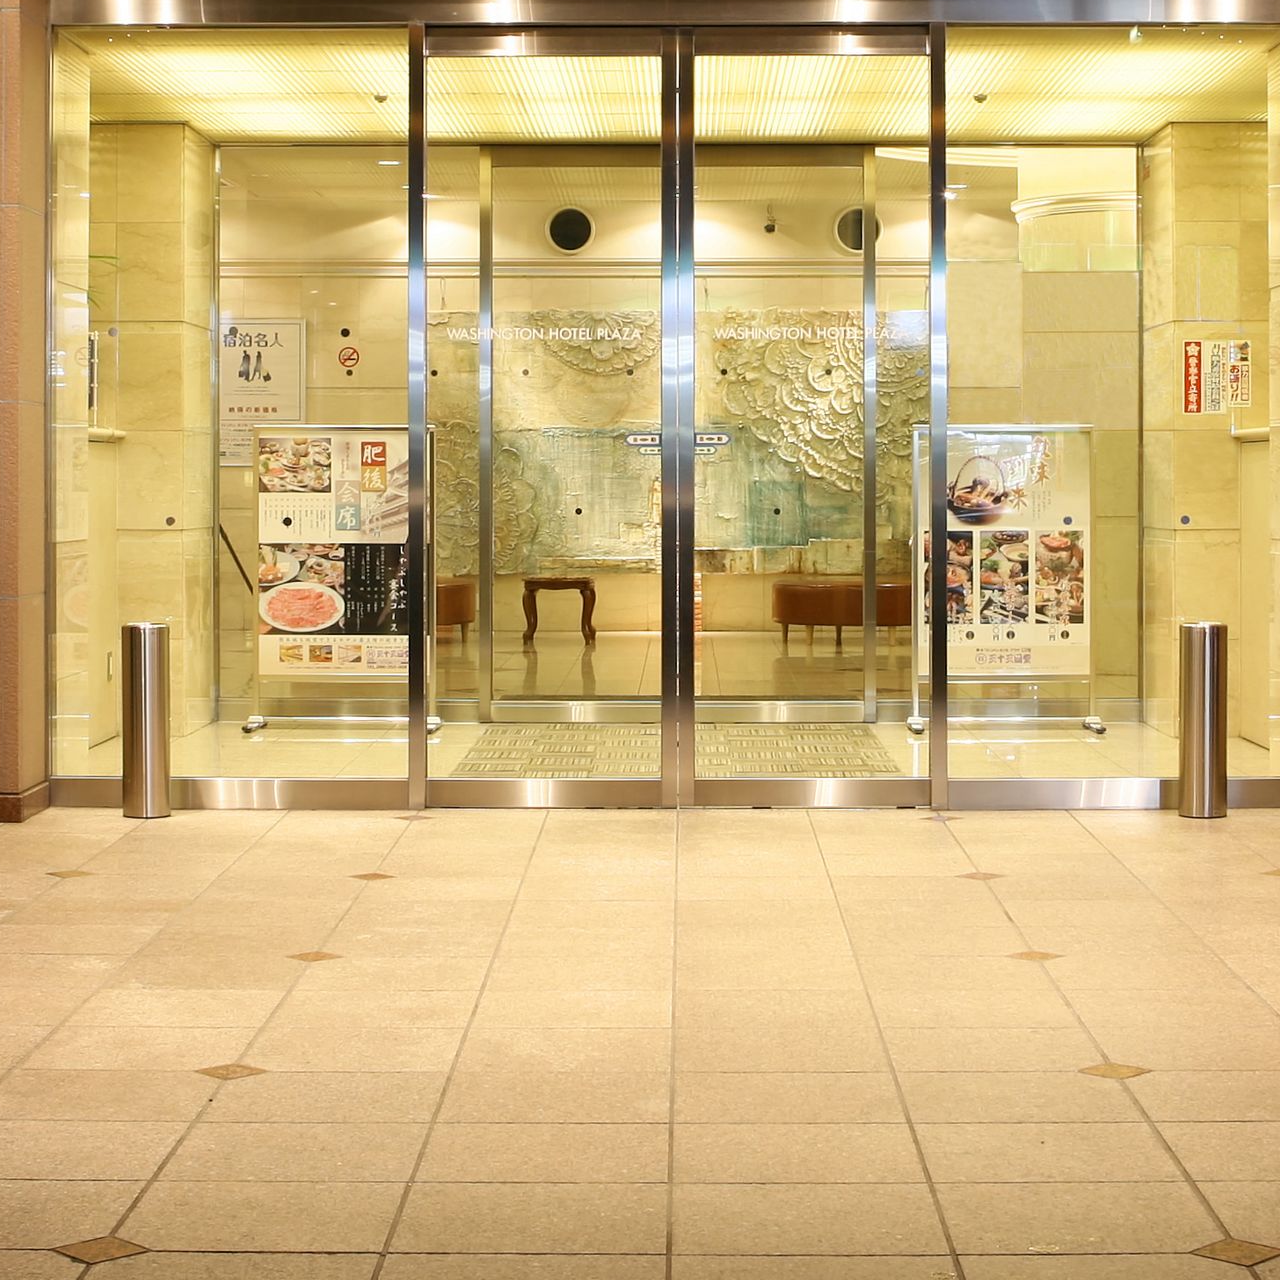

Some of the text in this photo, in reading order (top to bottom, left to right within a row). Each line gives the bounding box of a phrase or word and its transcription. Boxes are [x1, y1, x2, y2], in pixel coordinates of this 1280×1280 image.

[222, 331, 284, 348] 宿泊名人
[446, 327, 643, 341] WASHINGTON HOTEL PLAZA
[713, 326, 812, 340] WASHINGTON
[815, 326, 864, 340] HOTEL
[361, 444, 387, 490] 肥後
[335, 481, 359, 530] 会席
